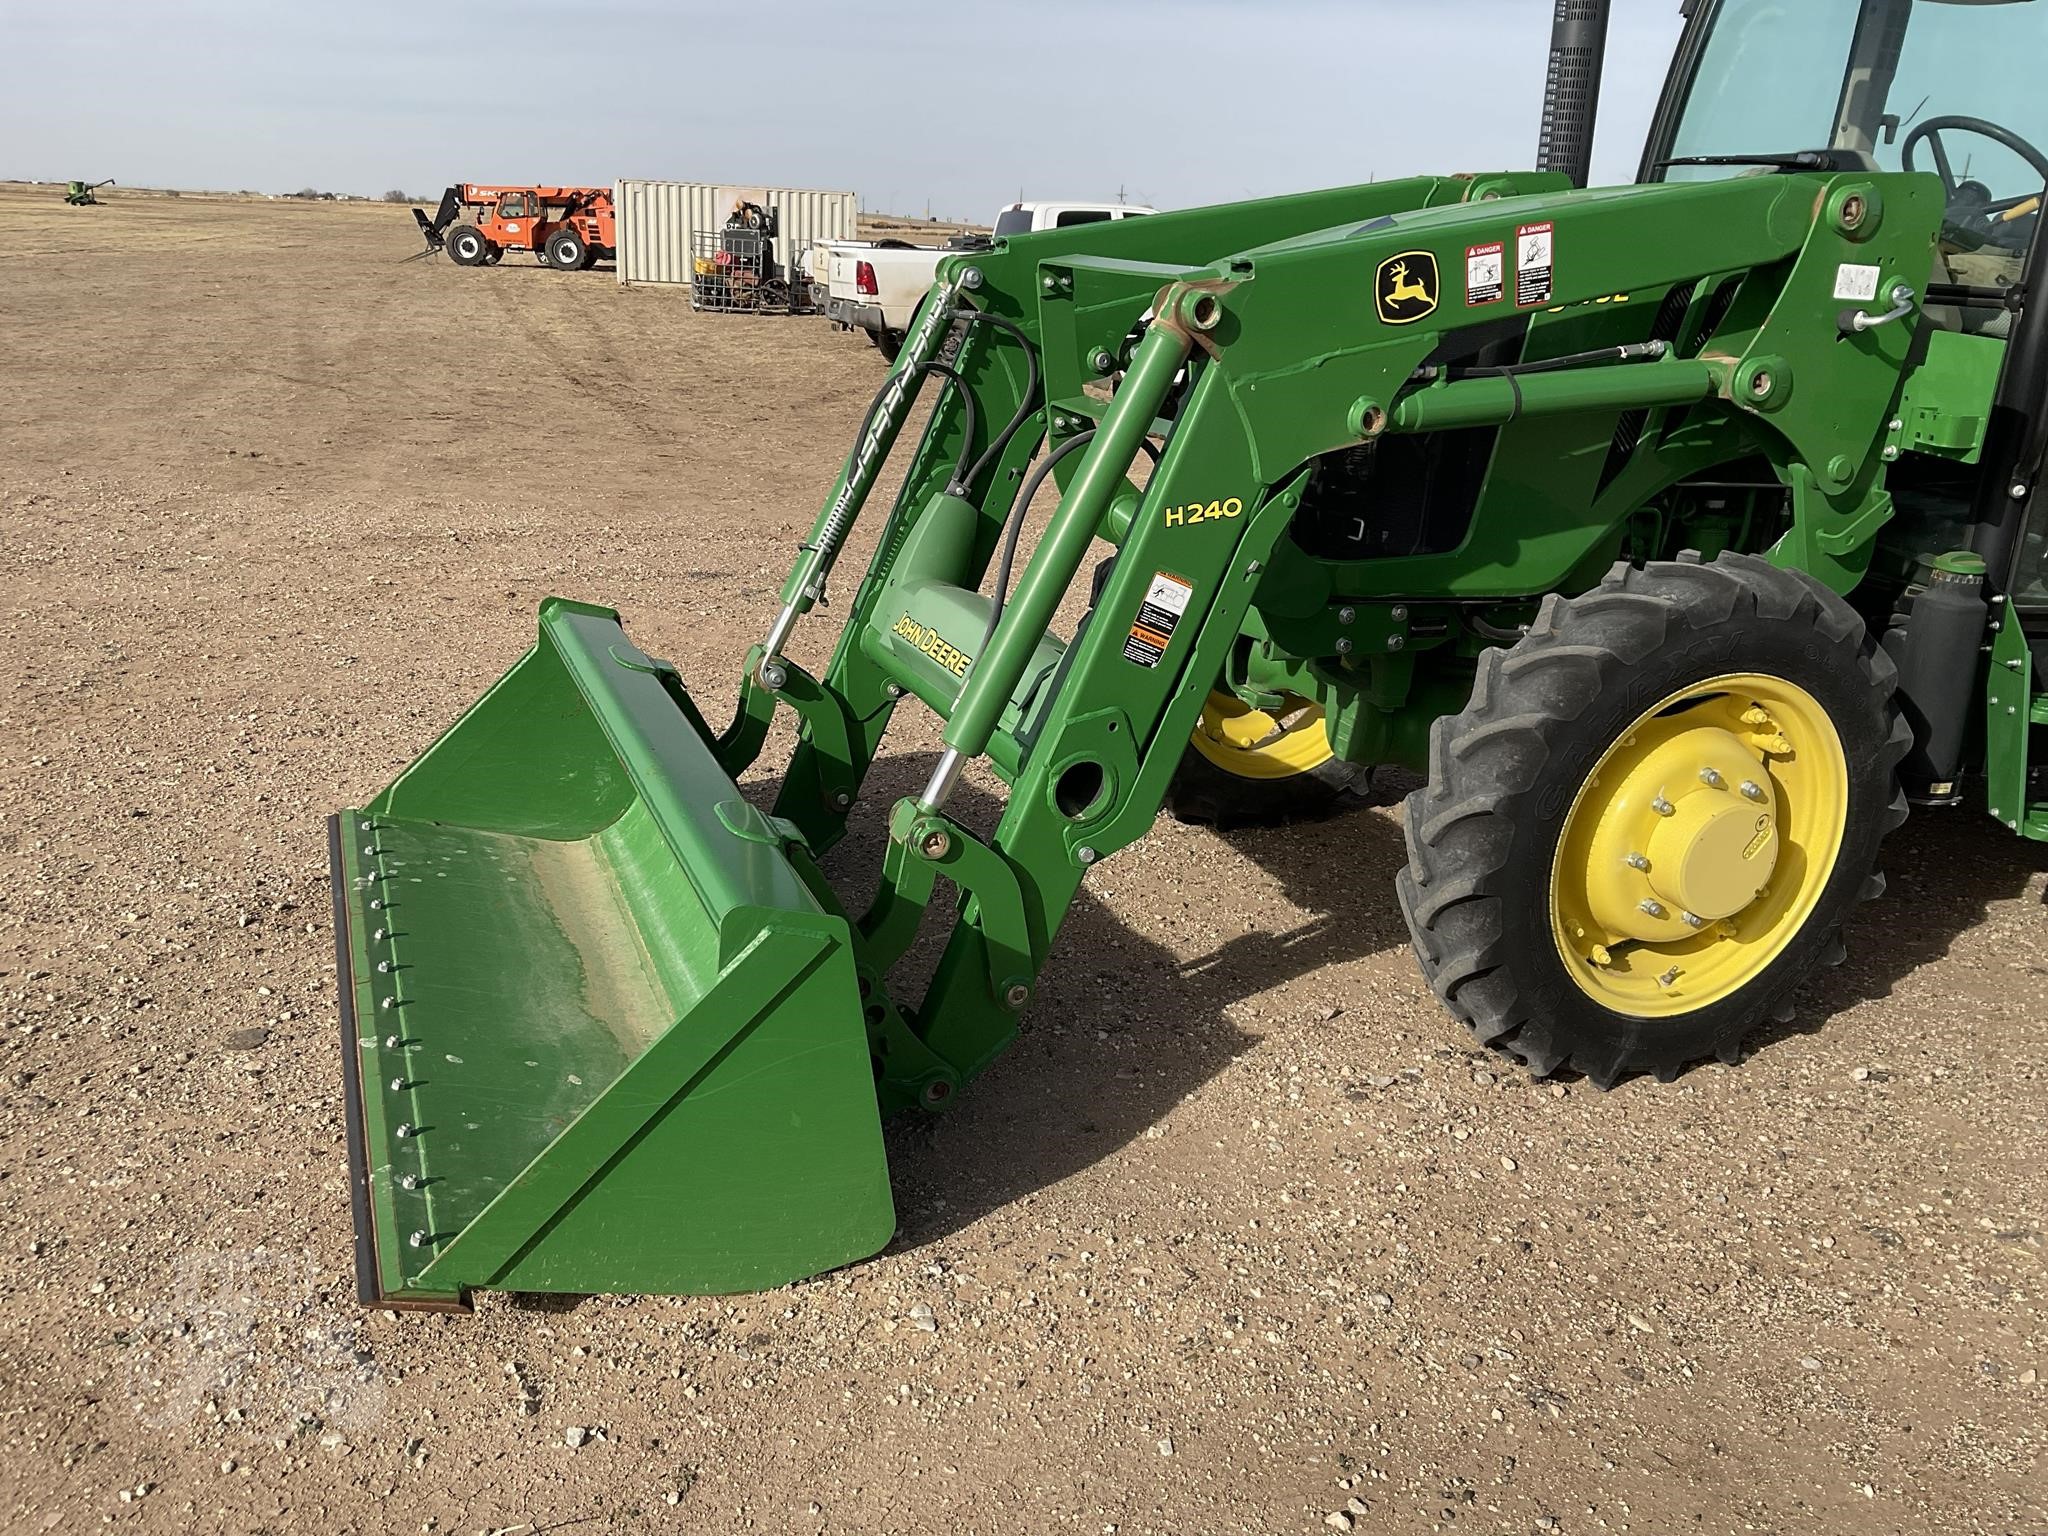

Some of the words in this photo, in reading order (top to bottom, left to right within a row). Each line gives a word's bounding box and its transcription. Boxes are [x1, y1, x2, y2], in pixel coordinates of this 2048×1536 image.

[1527, 224, 1551, 233] DANGER
[1476, 245, 1501, 255] DANGER
[1165, 497, 1243, 528] H240
[892, 610, 926, 646] JOHN
[919, 628, 973, 678] DEERE
[1140, 633, 1166, 647] WARNING
